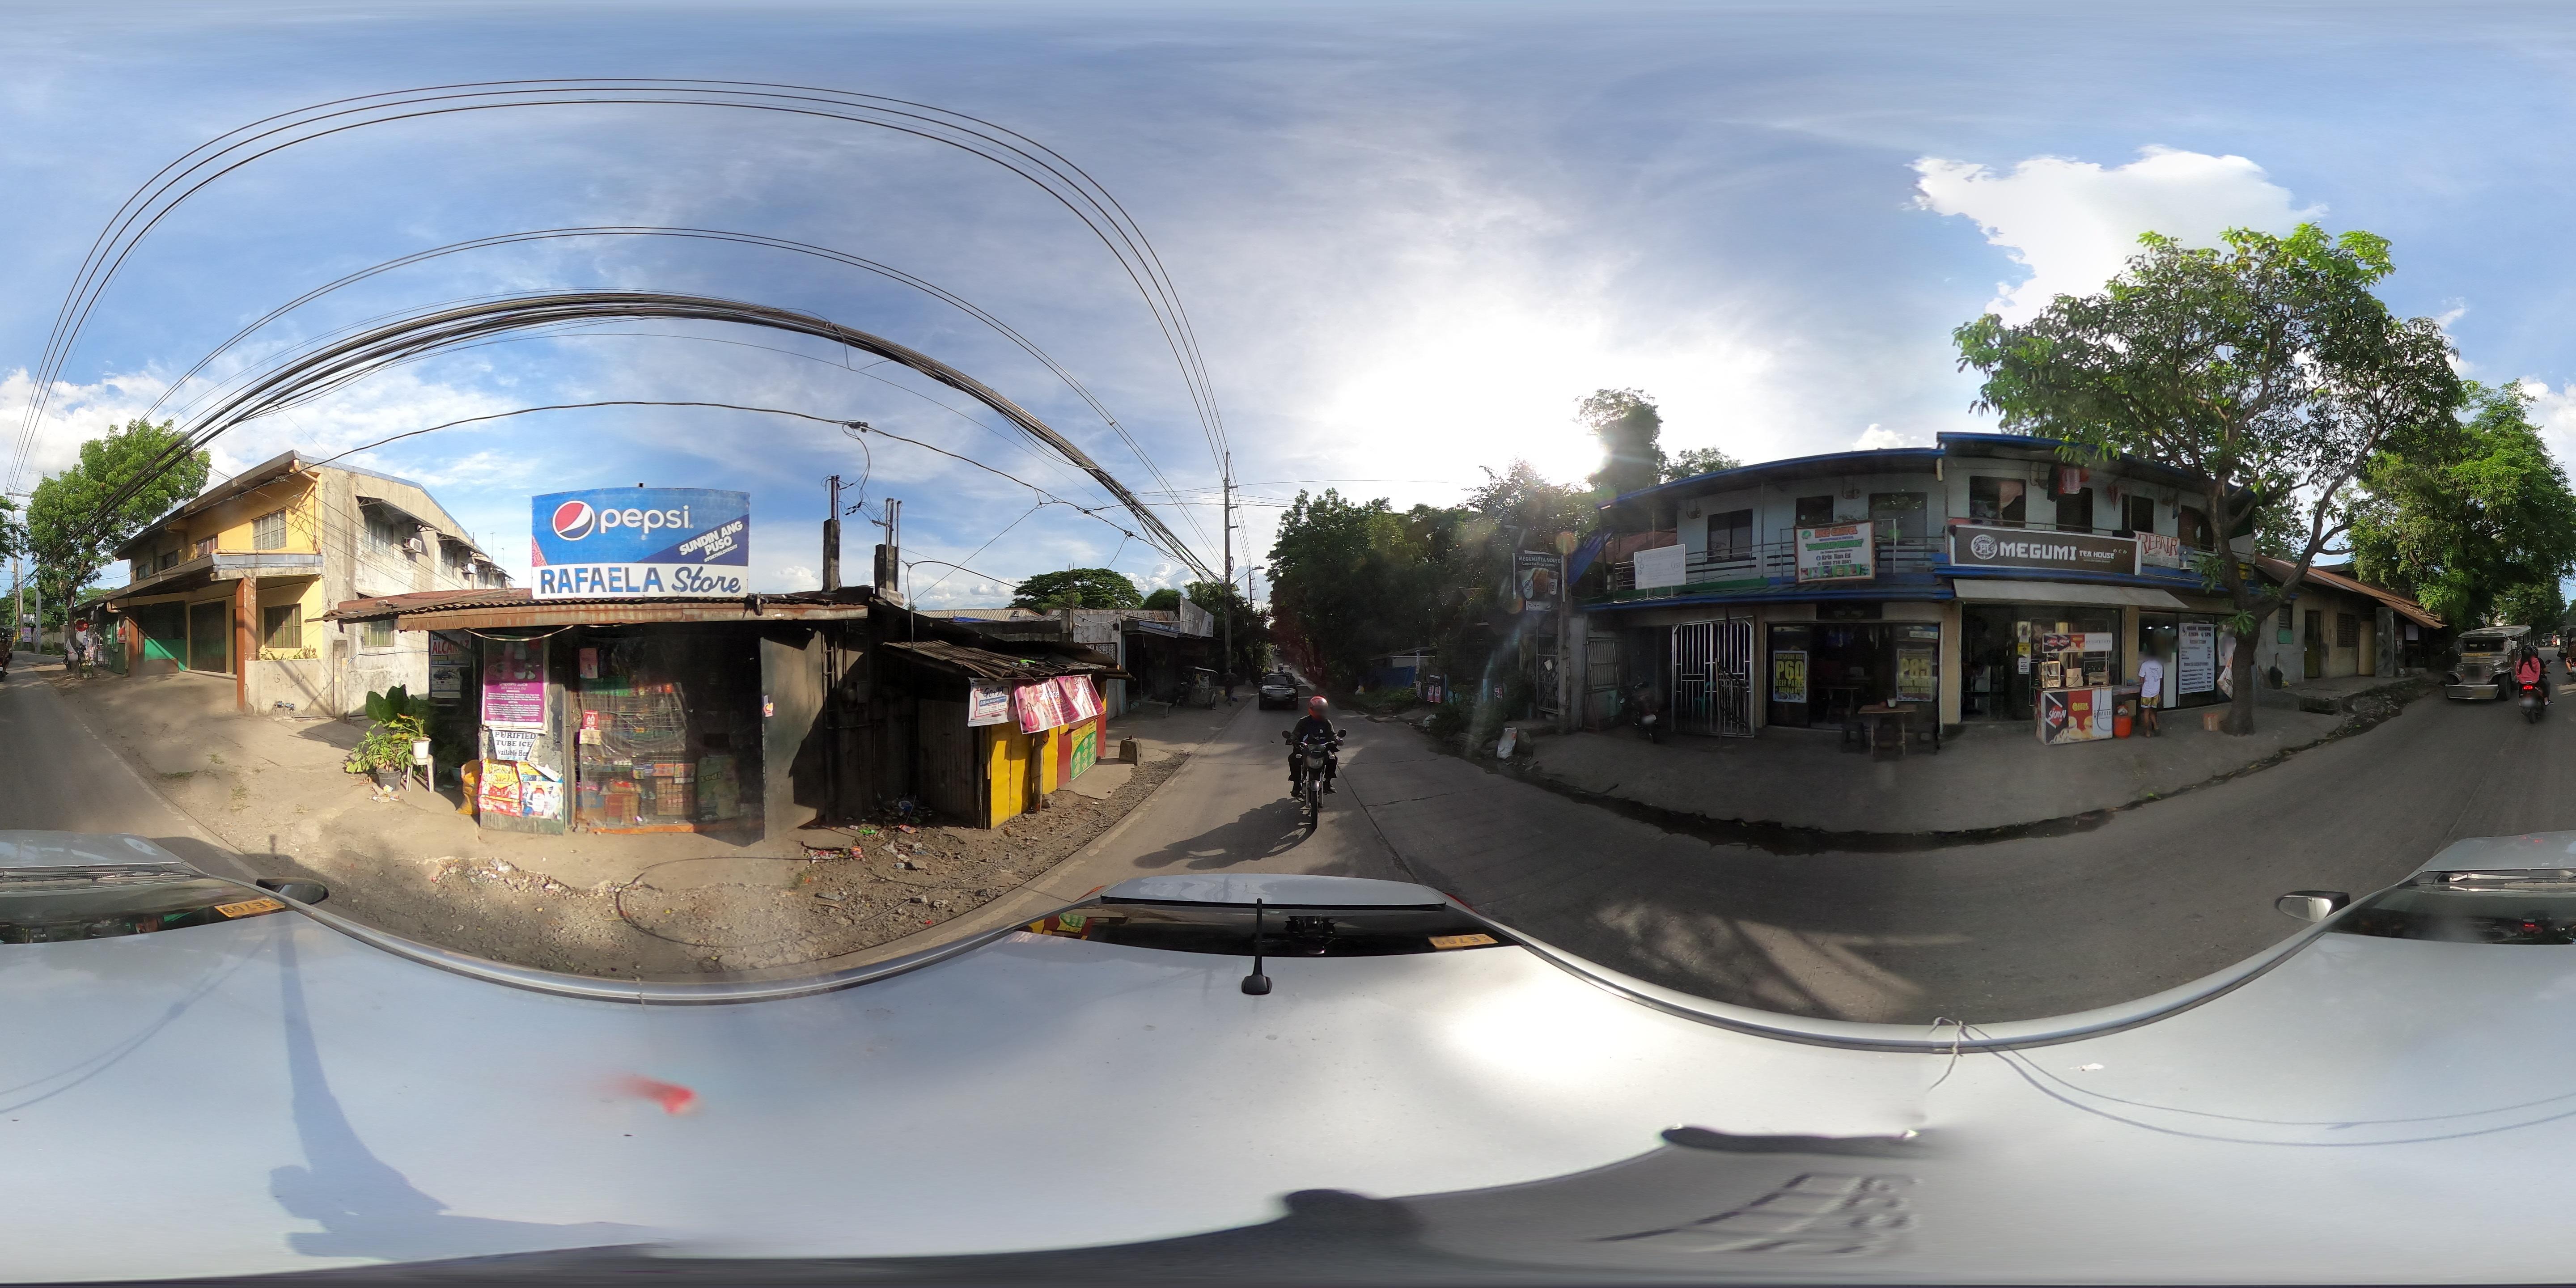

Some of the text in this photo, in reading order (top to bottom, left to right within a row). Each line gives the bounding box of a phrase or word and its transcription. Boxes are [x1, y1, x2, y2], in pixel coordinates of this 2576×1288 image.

[600, 505, 690, 534] pepsi
[679, 521, 743, 556] SUNDIN ANG
[704, 536, 732, 555] PUSO
[2138, 534, 2178, 556] REPAIR
[2000, 541, 2077, 561] MEGUMI
[540, 566, 741, 594] RAFAELA Store
[432, 640, 469, 654] ALCAZ
[1775, 661, 1804, 680] P60
[495, 731, 536, 739] PURIFIED
